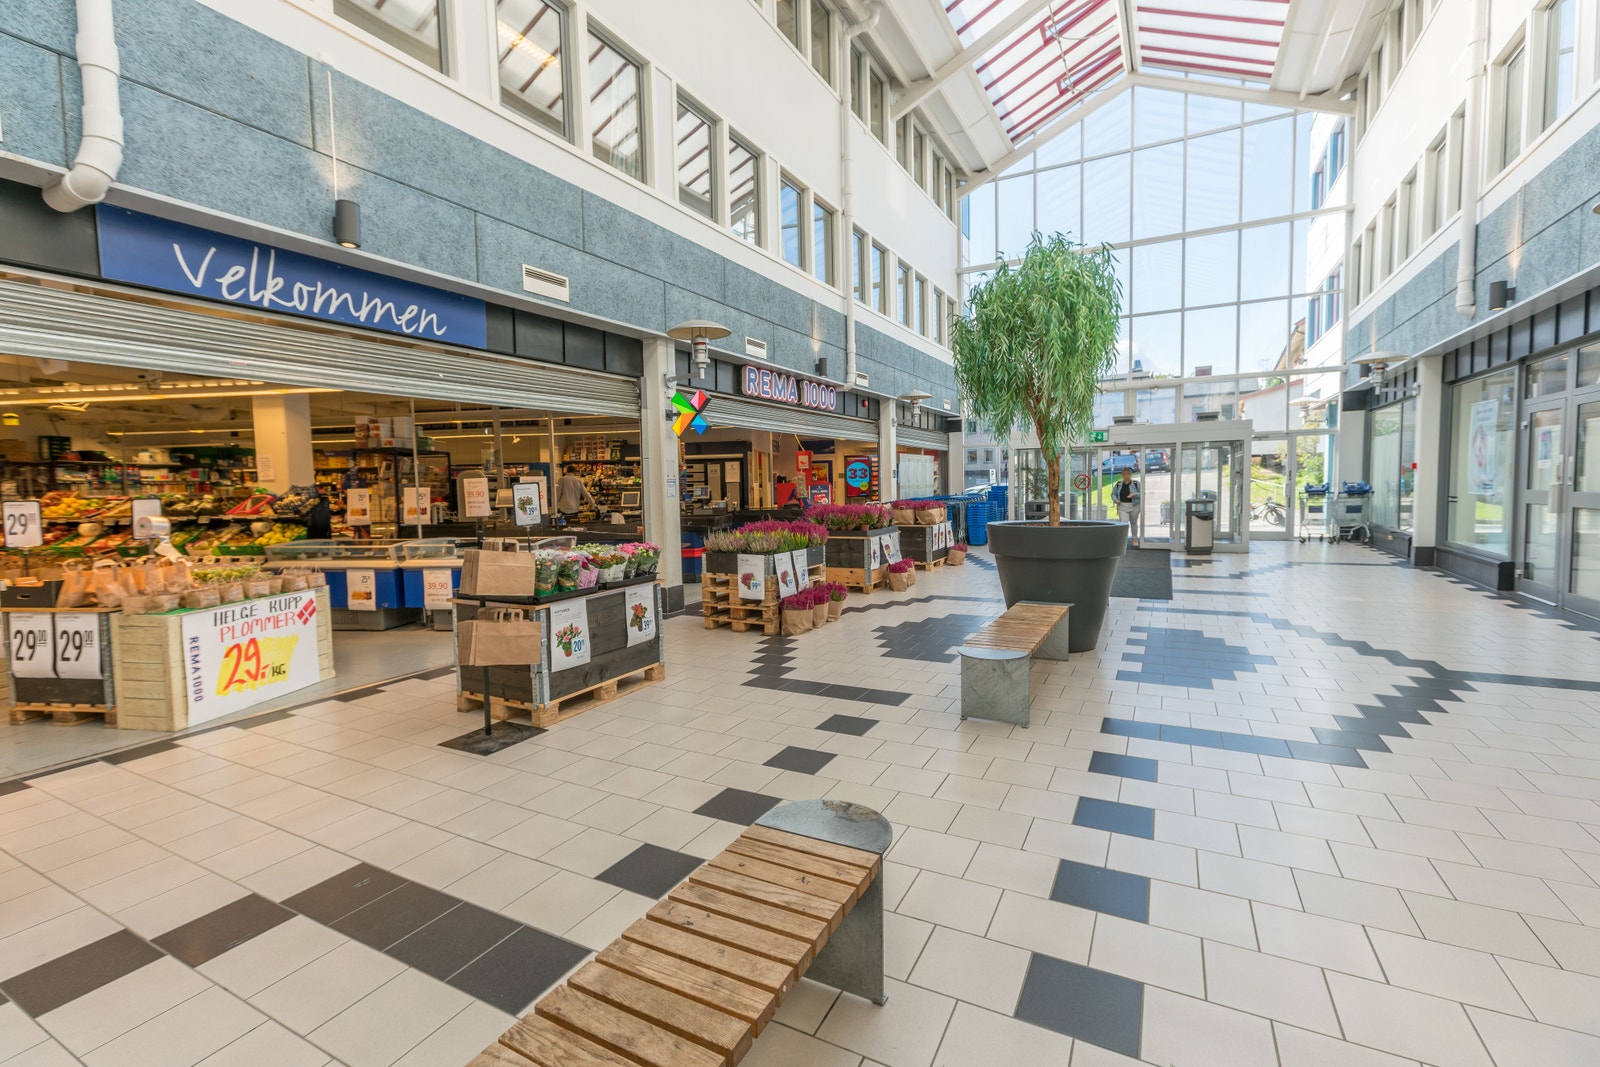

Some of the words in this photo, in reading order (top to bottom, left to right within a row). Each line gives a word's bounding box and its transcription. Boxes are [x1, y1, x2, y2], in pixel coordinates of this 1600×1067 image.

[172, 243, 447, 336] Velkommen
[744, 365, 799, 404] REMA
[802, 379, 837, 410] 1000
[428, 582, 448, 590] 39,90
[213, 604, 259, 627] HELGE
[269, 595, 302, 613] KUPP
[219, 611, 296, 643] PLOMMER
[189, 636, 201, 675] REMA
[192, 675, 204, 702] 1000
